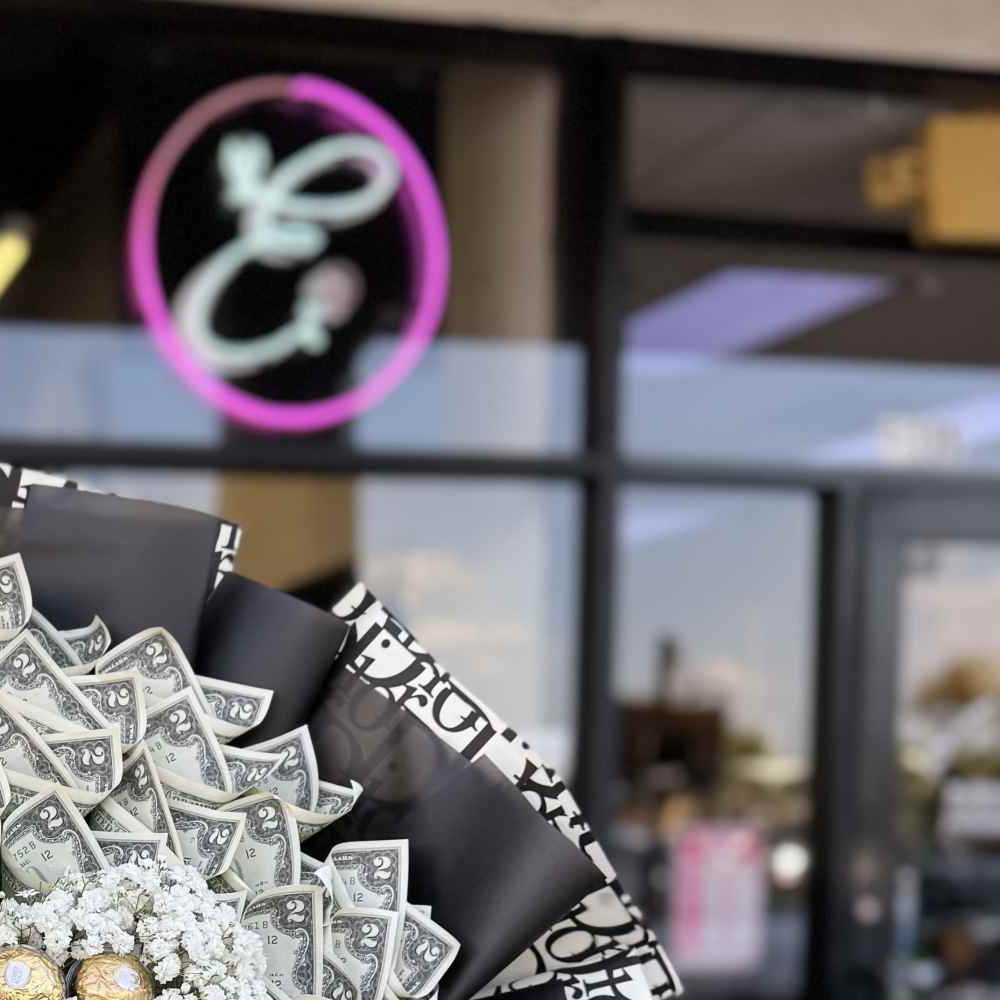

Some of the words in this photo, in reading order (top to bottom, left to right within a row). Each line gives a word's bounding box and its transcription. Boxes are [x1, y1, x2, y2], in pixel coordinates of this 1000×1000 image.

[146, 642, 167, 664] 2
[14, 654, 35, 676] 2
[169, 709, 192, 732] 2
[40, 805, 63, 830] 2
[258, 806, 279, 830] 2
[373, 856, 391, 880] 2
[286, 900, 304, 922] 2
[361, 923, 379, 947] 2
[417, 942, 439, 961] 2
